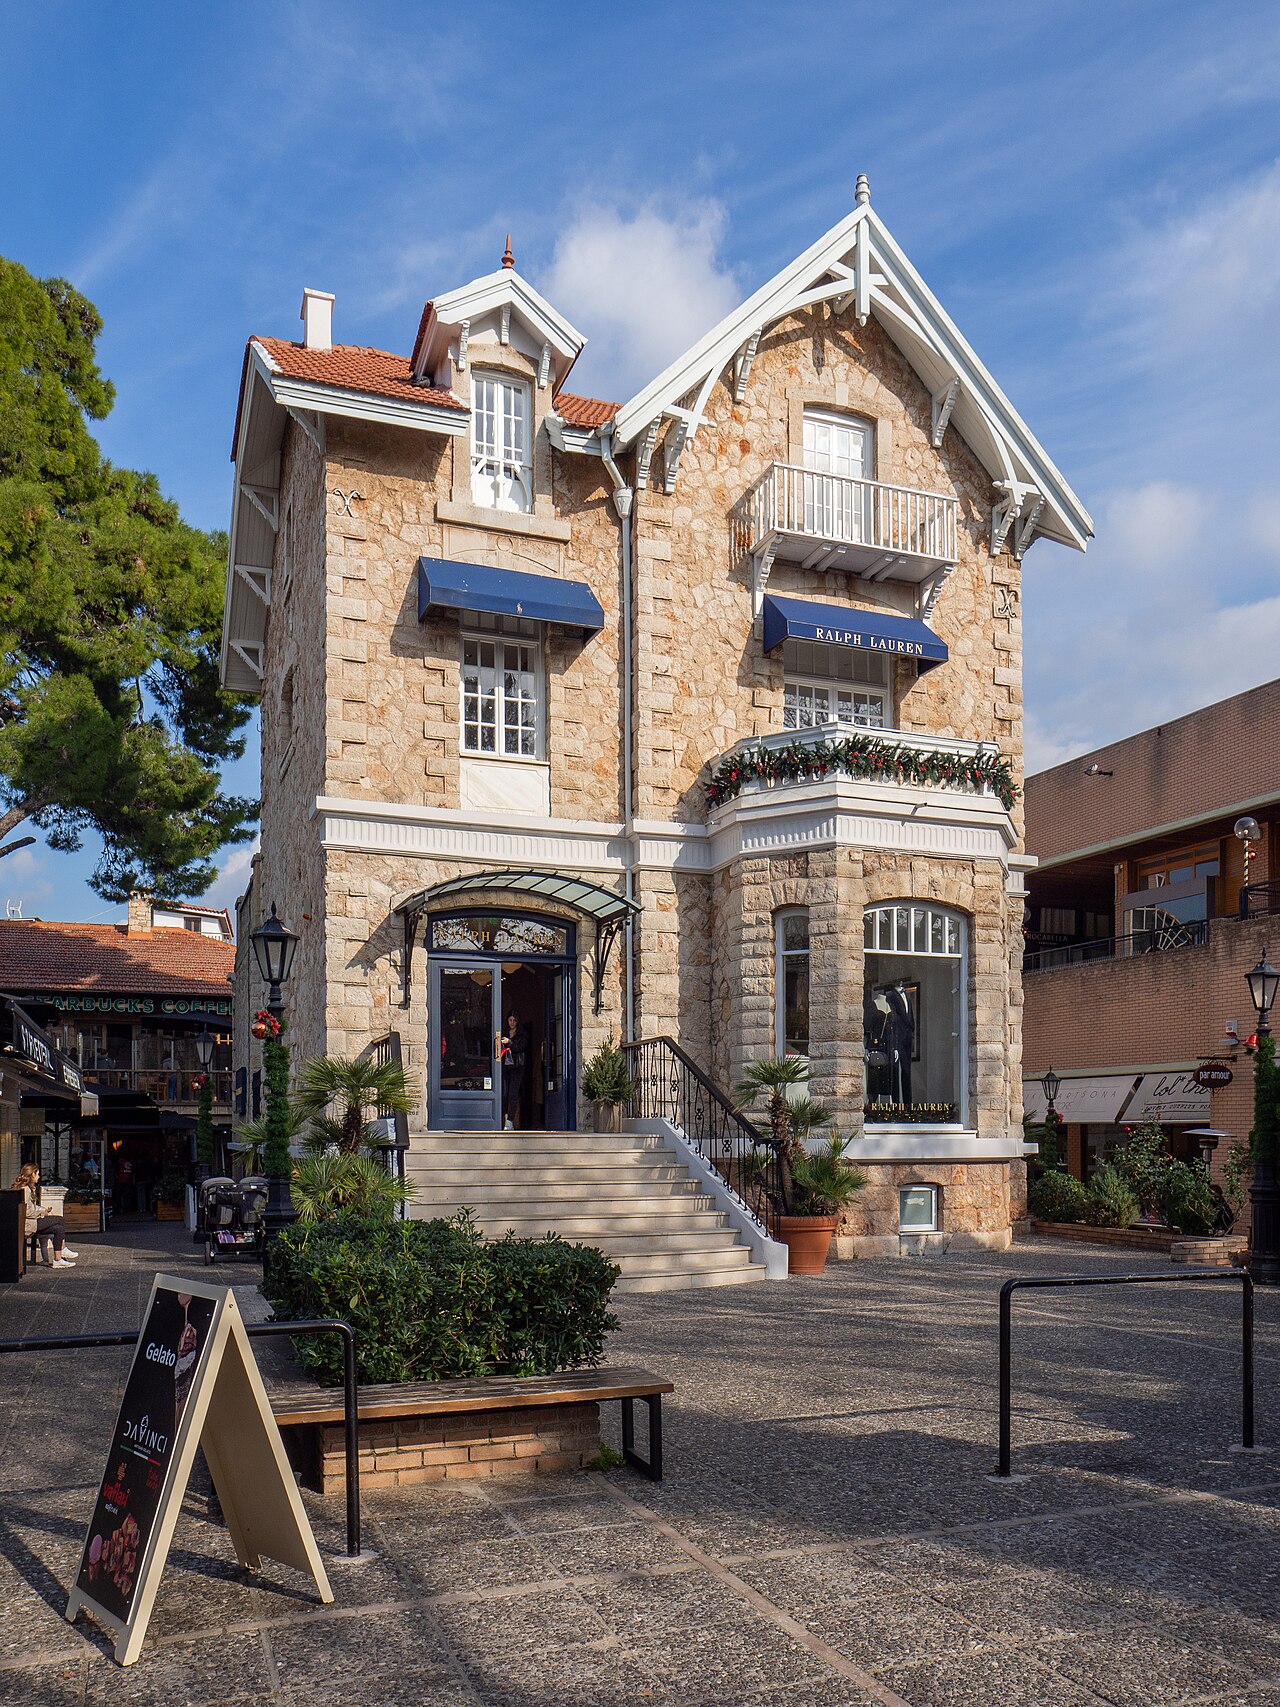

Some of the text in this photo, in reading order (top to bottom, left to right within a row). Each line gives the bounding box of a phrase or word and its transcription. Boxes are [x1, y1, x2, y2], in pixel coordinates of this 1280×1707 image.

[816, 627, 923, 655] RALPH LAUREN
[437, 929, 563, 946] RALPH LAUREN
[27, 995, 233, 1015] TARBUCKS COFFE
[1199, 1070, 1231, 1081] par amour
[1057, 1090, 1117, 1100] ARTSONA
[871, 1102, 950, 1111] RALPH LAUREN
[145, 1342, 176, 1367] Gelato
